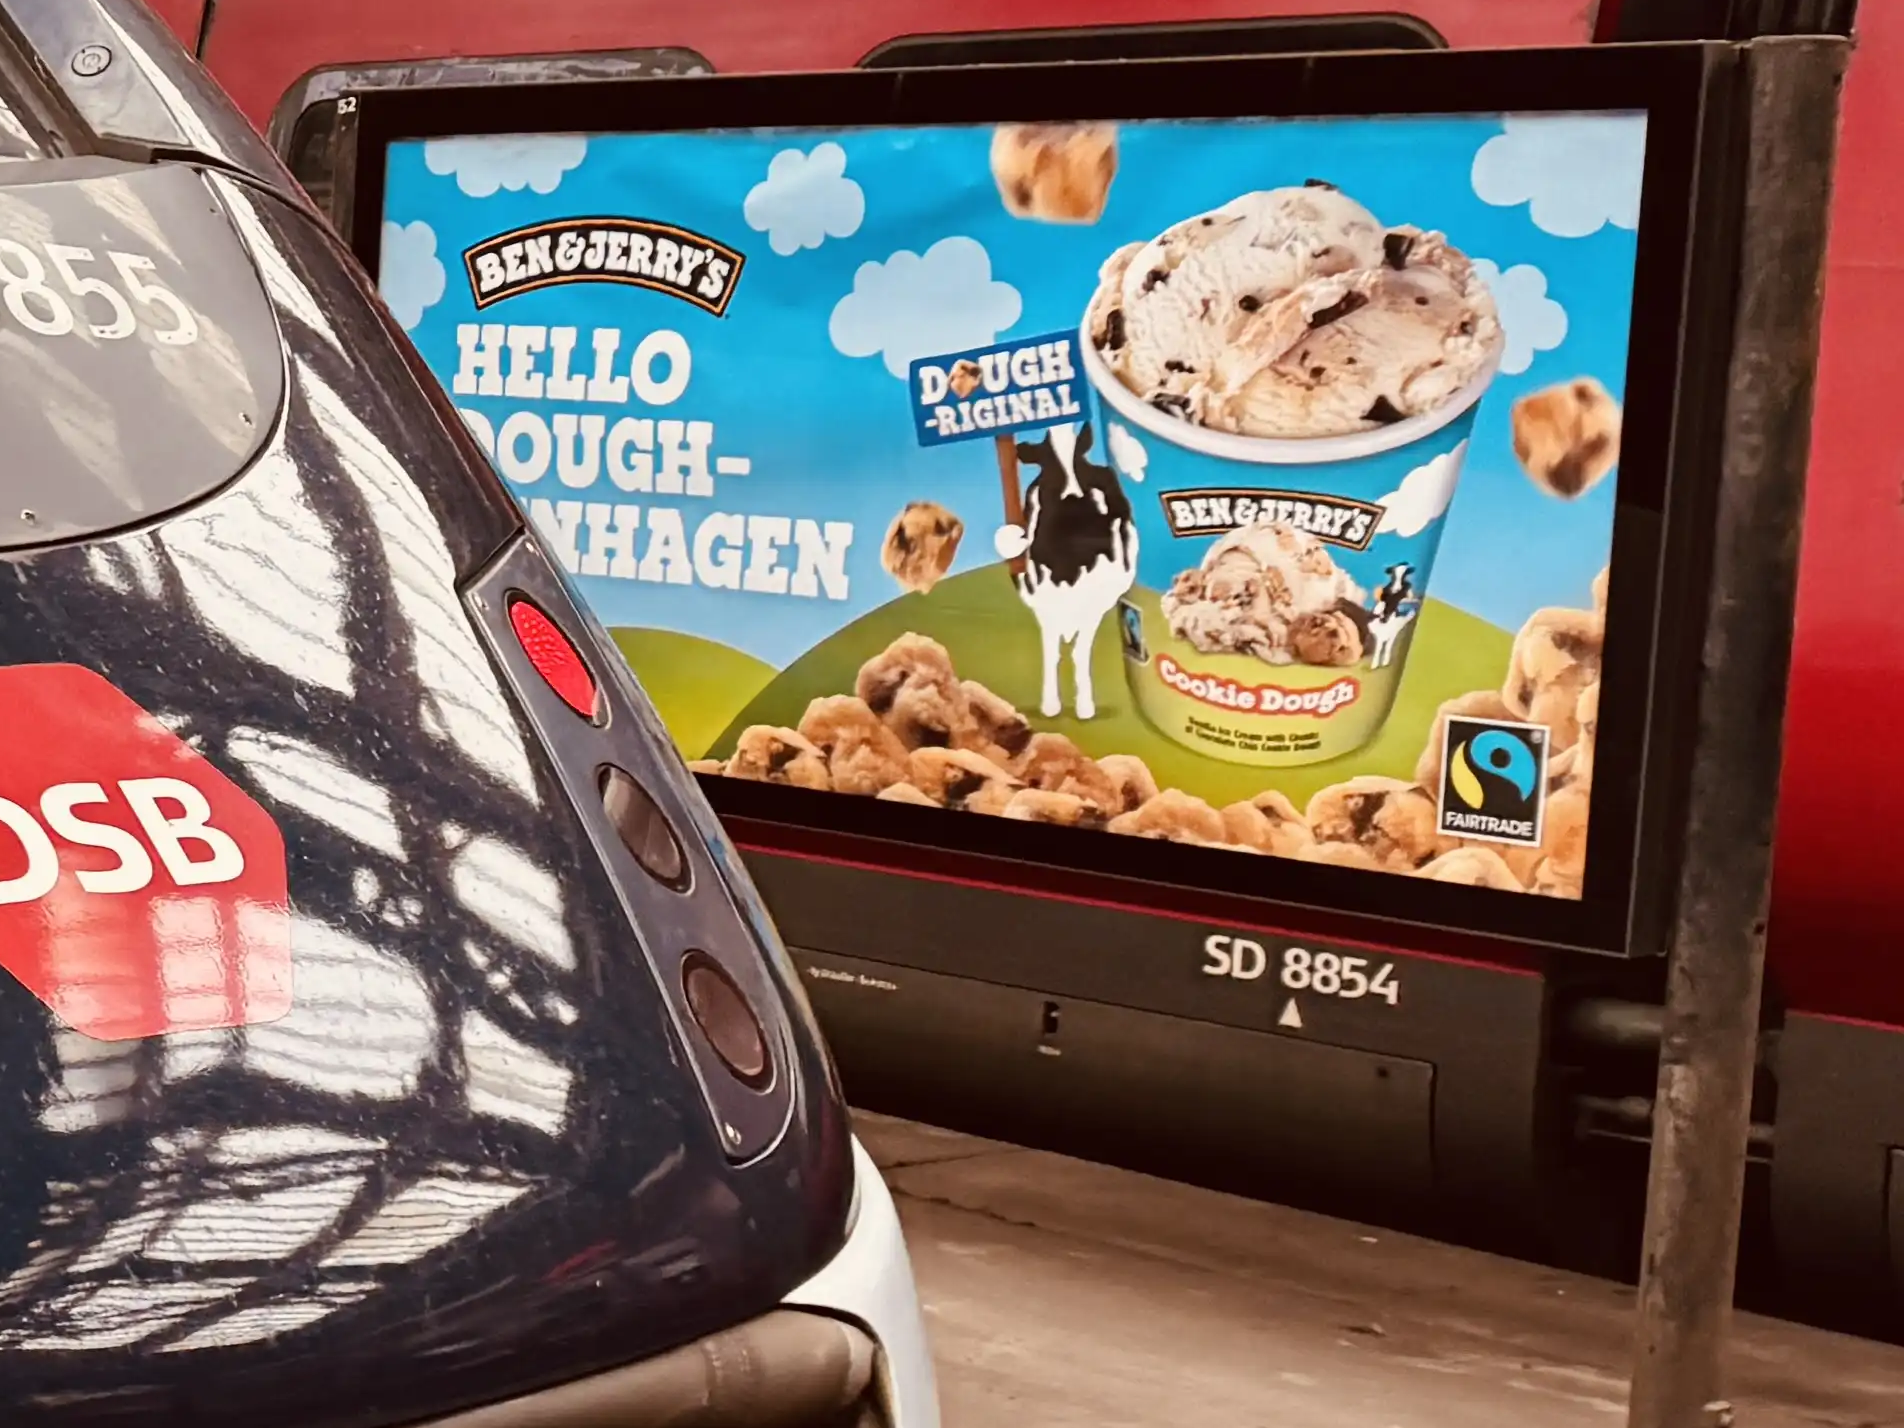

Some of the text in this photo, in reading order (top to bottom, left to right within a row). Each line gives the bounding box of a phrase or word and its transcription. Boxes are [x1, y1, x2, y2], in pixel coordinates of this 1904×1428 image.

[453, 323, 692, 406] HELLO
[924, 383, 1081, 437] -RIGINAL
[1160, 659, 1354, 714] Cookie Dough
[1445, 811, 1534, 837] FAIRTRADE
[1202, 934, 1400, 1006] SD 8854
